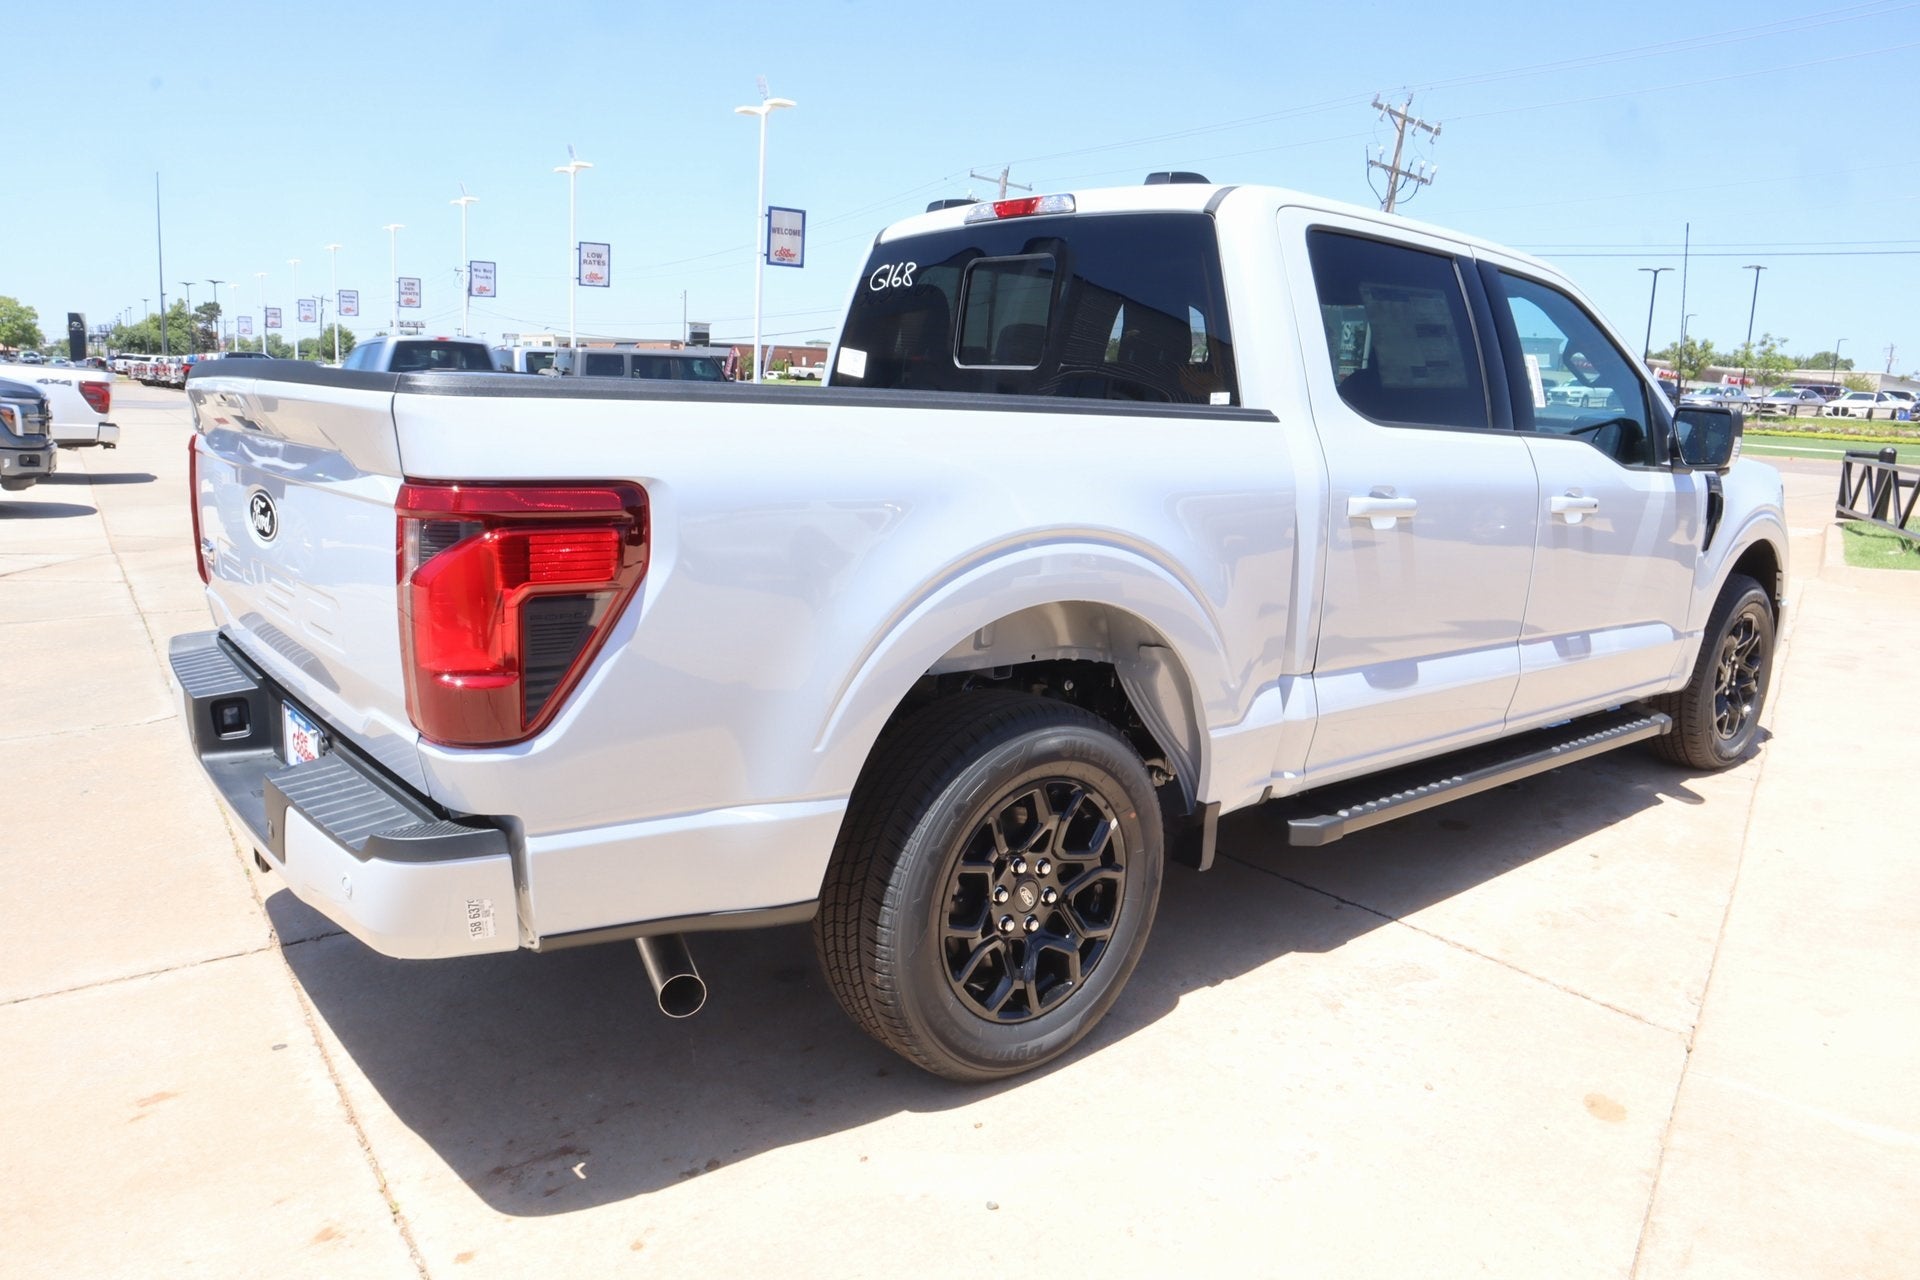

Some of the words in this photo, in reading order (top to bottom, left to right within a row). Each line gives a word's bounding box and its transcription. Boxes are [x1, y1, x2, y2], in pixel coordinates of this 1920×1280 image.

[772, 227, 801, 237] WELCOME
[582, 259, 606, 267] RATES
[869, 261, 917, 291] G168
[470, 921, 483, 937] 158
